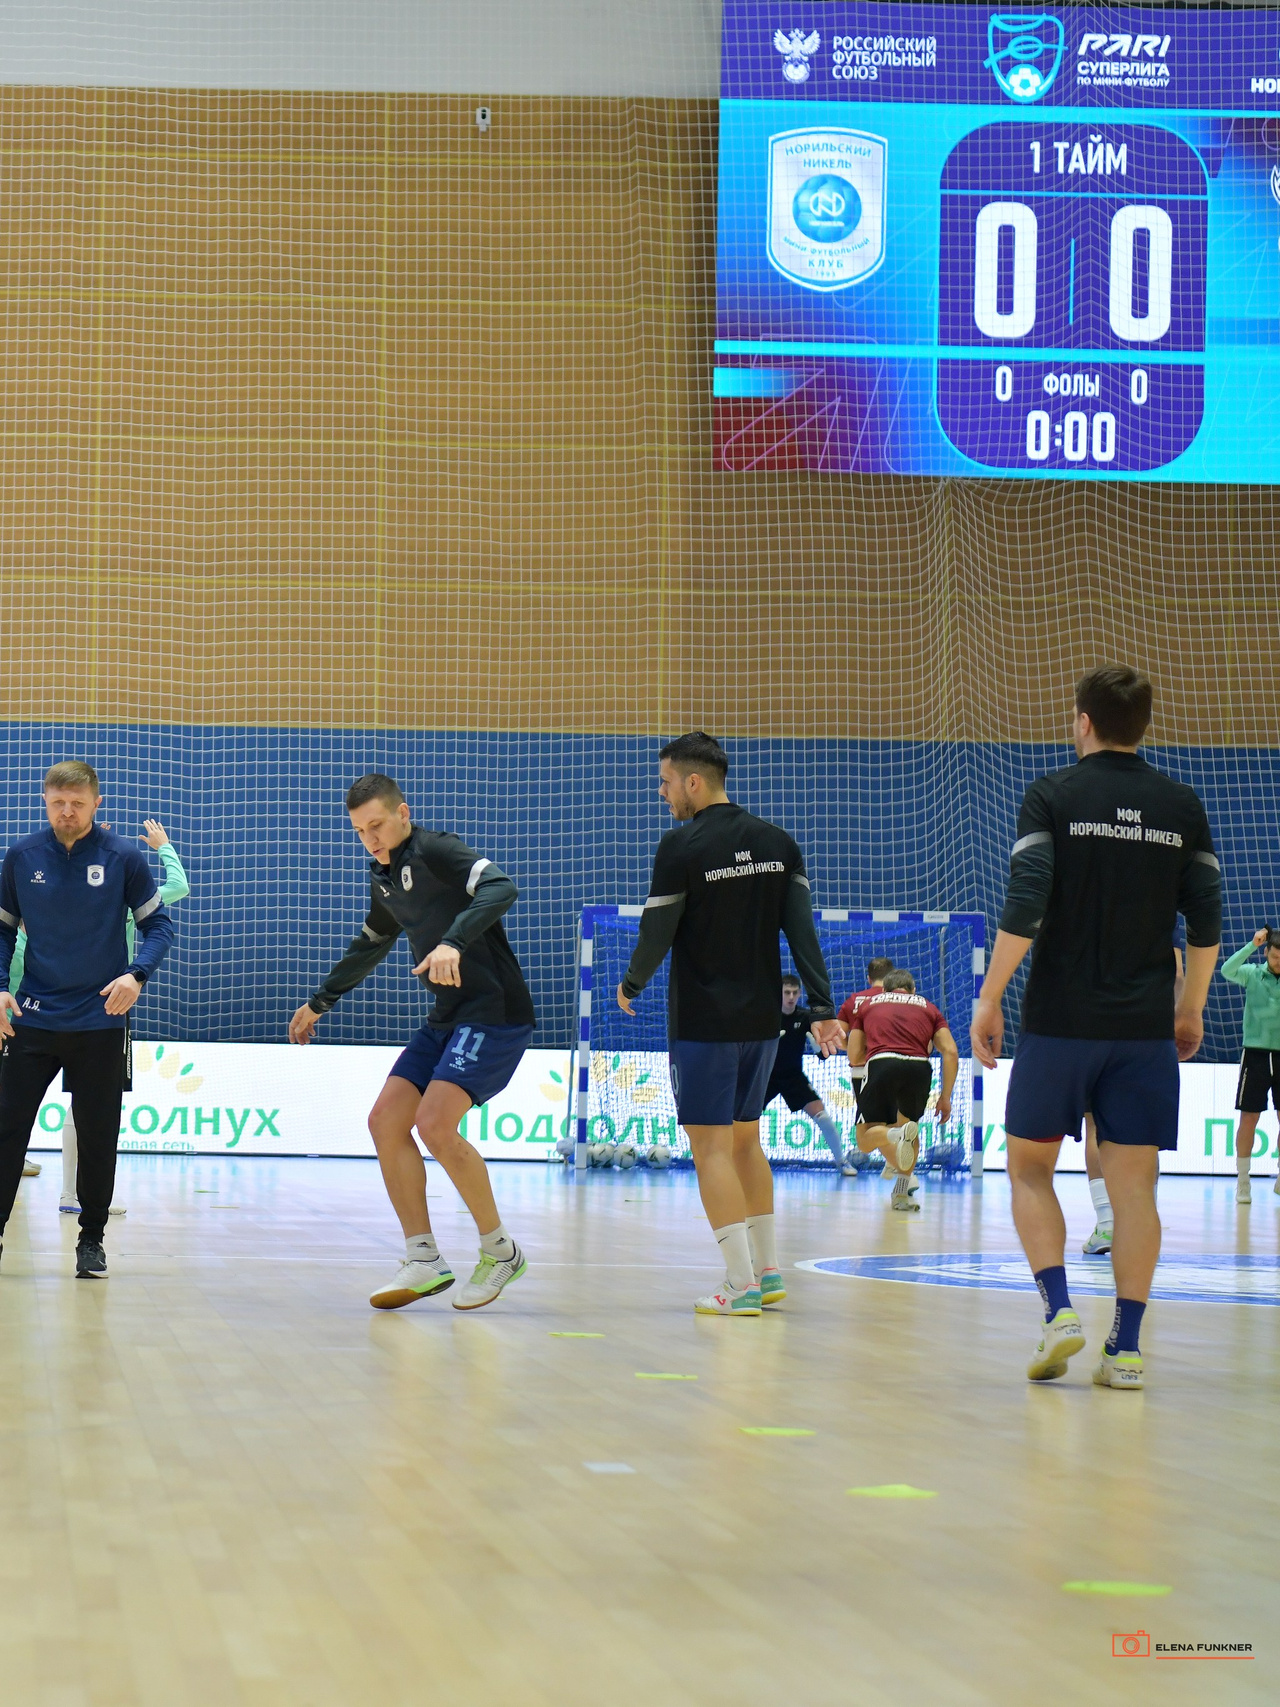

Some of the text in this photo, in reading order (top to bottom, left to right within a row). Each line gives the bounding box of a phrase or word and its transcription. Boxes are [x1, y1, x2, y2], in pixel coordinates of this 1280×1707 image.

[832, 35, 937, 52] РОССИЙСКИЙ
[1077, 33, 1171, 57] PARI
[832, 50, 937, 67] ФУТБОЛЬНЫЙ
[831, 65, 879, 80] СОЮЗ
[1076, 61, 1170, 77] СУПЕРЛИГА
[1076, 77, 1170, 87] ПО МИНИ-ФУТБОЛУ
[1250, 78, 1280, 93] НО
[785, 142, 873, 158] НОРИЛЬСКИЙ
[1029, 134, 1128, 175] 1 ТАЙМ
[803, 158, 852, 169] НИКЕЛЬ
[808, 259, 844, 268] КЛУБ
[973, 201, 1173, 342] 0 0
[995, 365, 1148, 405] 0 ФОЛЫ 0
[1026, 410, 1116, 462] 0:00
[1069, 822, 1183, 848] НОРИЛЬСКИЙ НИКЕЛЬ
[704, 861, 785, 882] НОРИЛЬСКИЙ НИКЕЛЬ
[451, 1026, 486, 1061] 11
